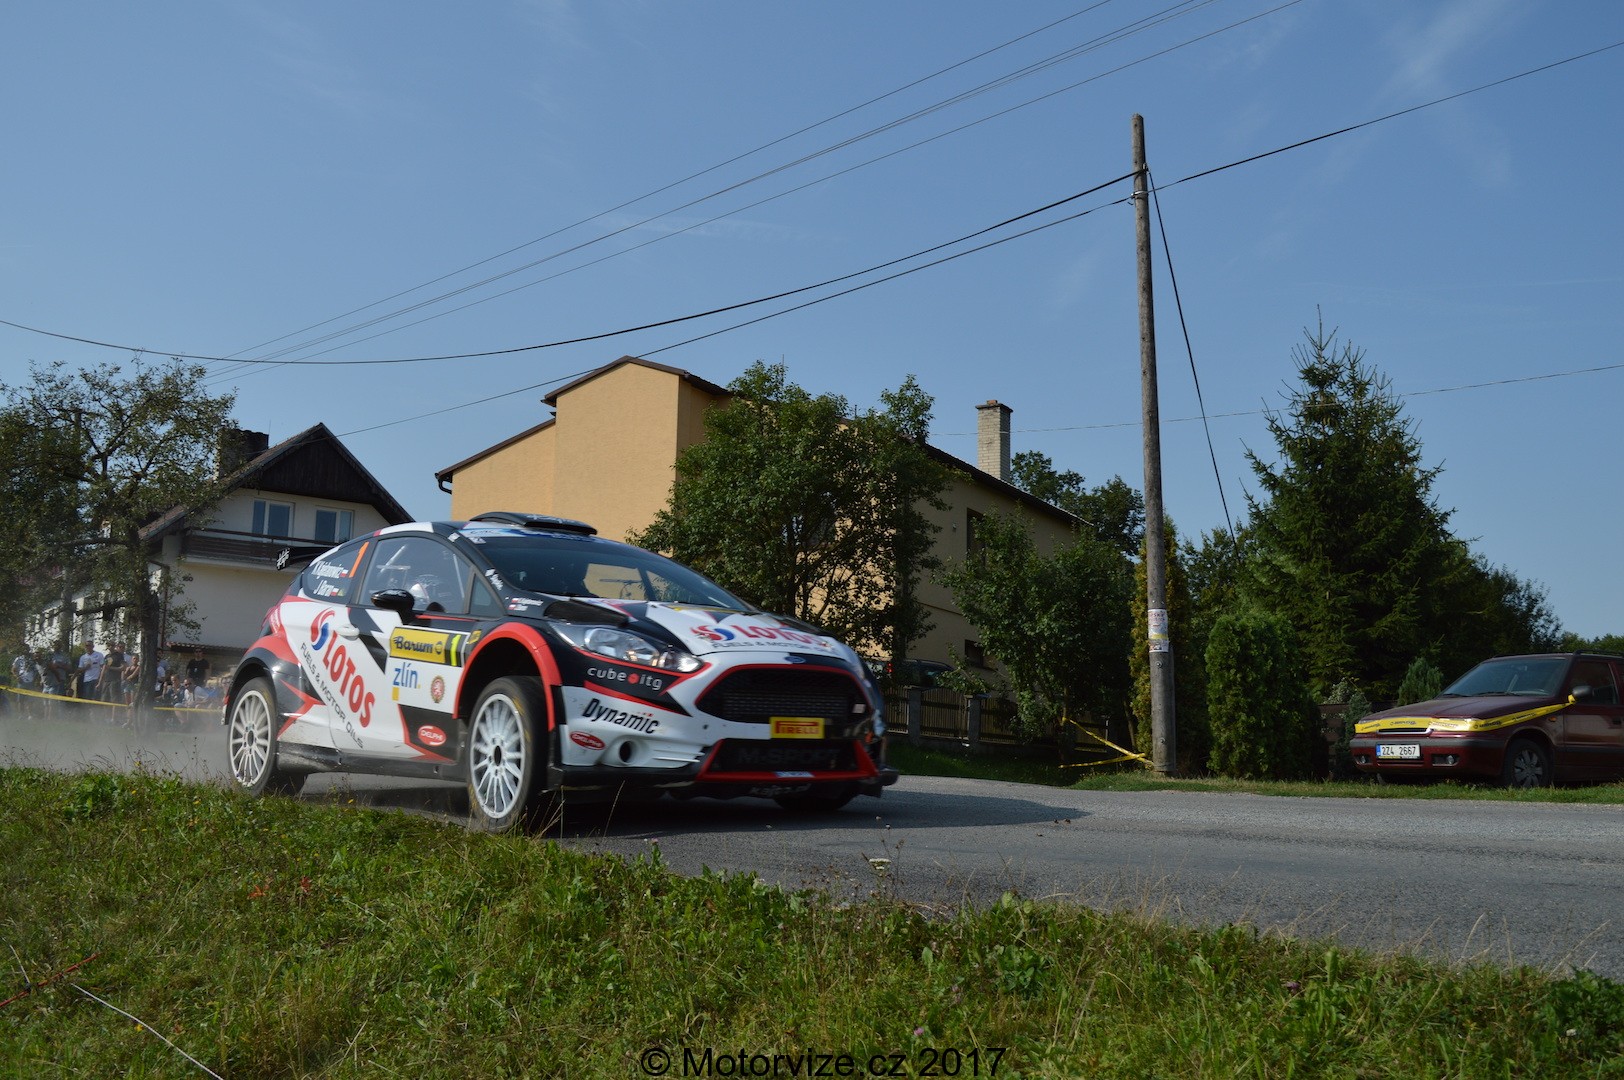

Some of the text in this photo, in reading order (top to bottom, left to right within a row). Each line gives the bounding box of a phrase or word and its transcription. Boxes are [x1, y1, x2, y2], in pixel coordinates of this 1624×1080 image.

[348, 541, 370, 578] 1
[394, 636, 433, 654] Barum
[731, 625, 834, 648] LOTOS
[450, 634, 461, 667] 1
[322, 630, 375, 728] LOTOS
[587, 668, 662, 690] cube itg
[301, 642, 316, 675] FUELS
[320, 682, 346, 723] MOTOR
[345, 721, 364, 749] OILS
[582, 698, 659, 734] Dynamic
[775, 720, 819, 734] PIRELLI
[421, 730, 443, 740] DELPHI
[1381, 746, 1394, 756] 2Z4
